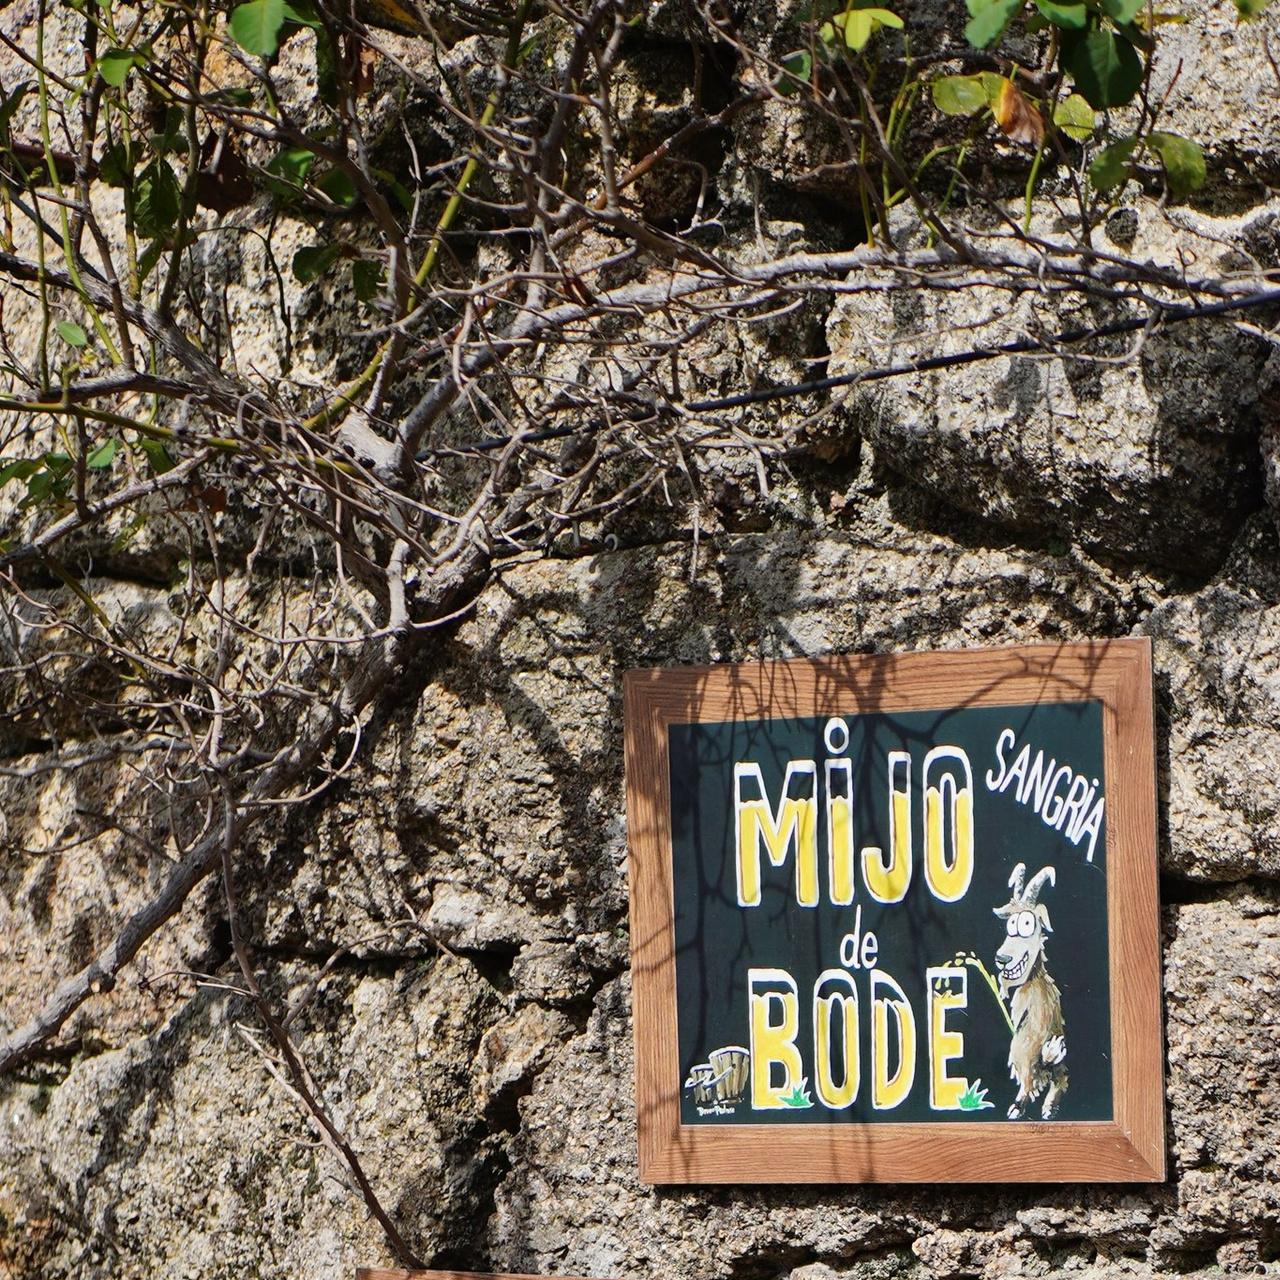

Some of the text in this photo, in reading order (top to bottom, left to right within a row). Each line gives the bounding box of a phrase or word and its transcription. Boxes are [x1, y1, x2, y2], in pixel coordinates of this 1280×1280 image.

[733, 717, 975, 908] MIJO
[985, 728, 1106, 862] SANGRIA
[840, 905, 879, 970] de
[748, 966, 970, 1112] BODE
